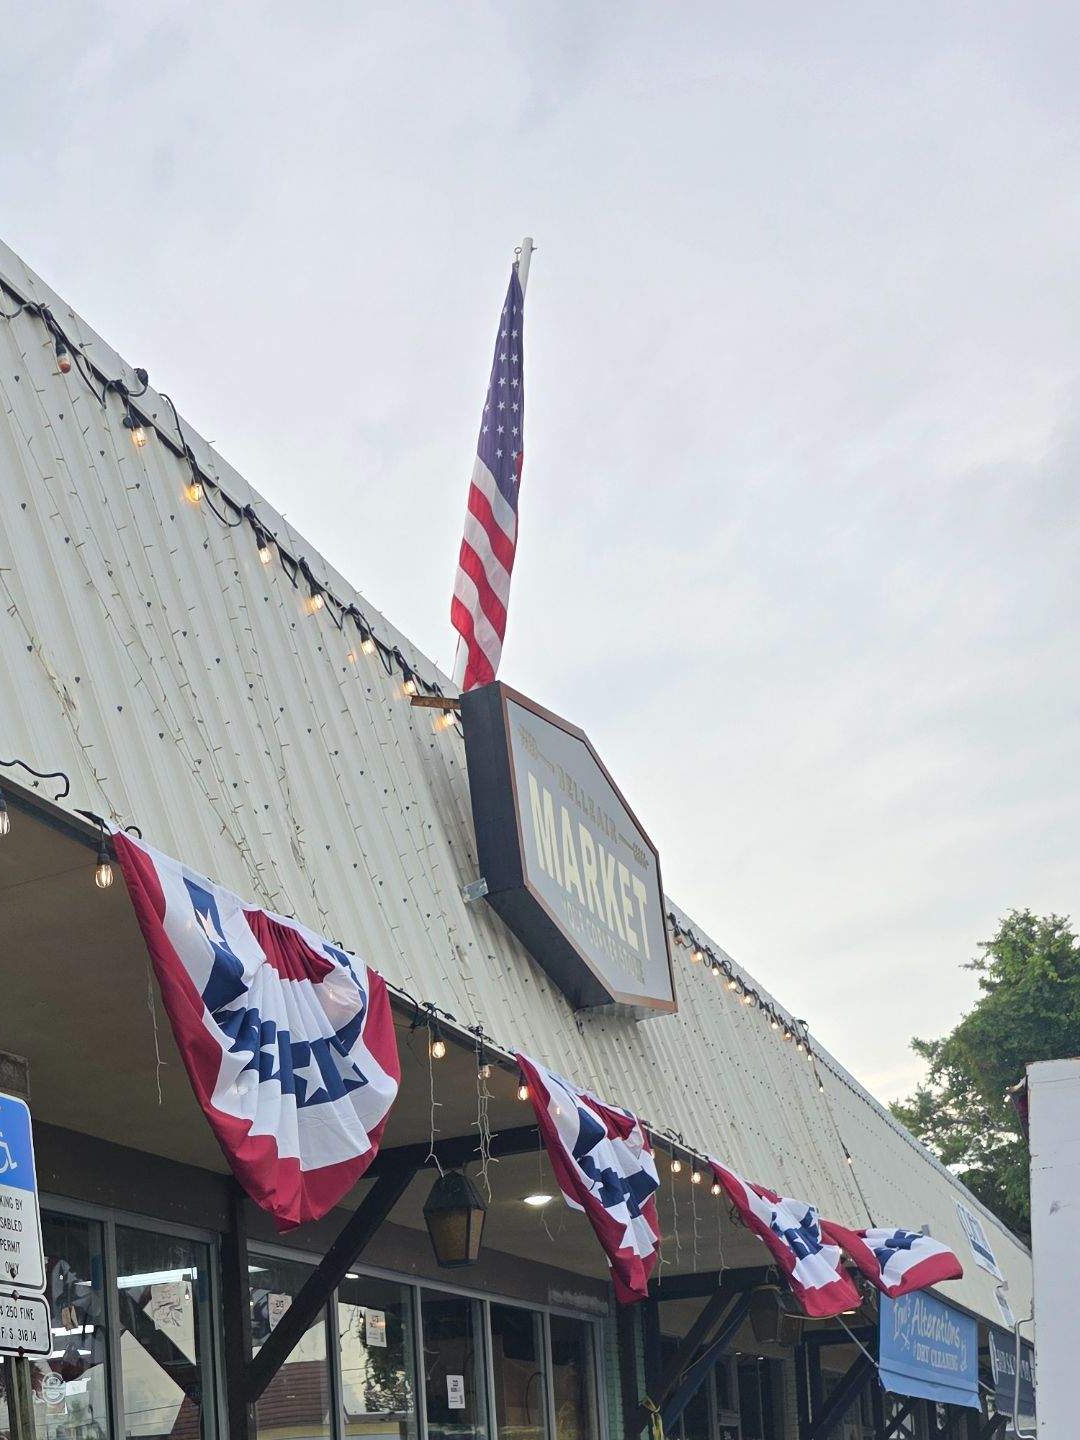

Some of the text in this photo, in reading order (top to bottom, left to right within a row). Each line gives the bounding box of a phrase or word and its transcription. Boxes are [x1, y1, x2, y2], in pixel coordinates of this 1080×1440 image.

[528, 770, 652, 962] MARKET
[15, 1198, 23, 1211] BY
[0, 1238, 21, 1254] PERMIT
[0, 1305, 35, 1321] $ 250 FINE
[910, 1297, 960, 1349] Alterations
[916, 1342, 930, 1363] DRY
